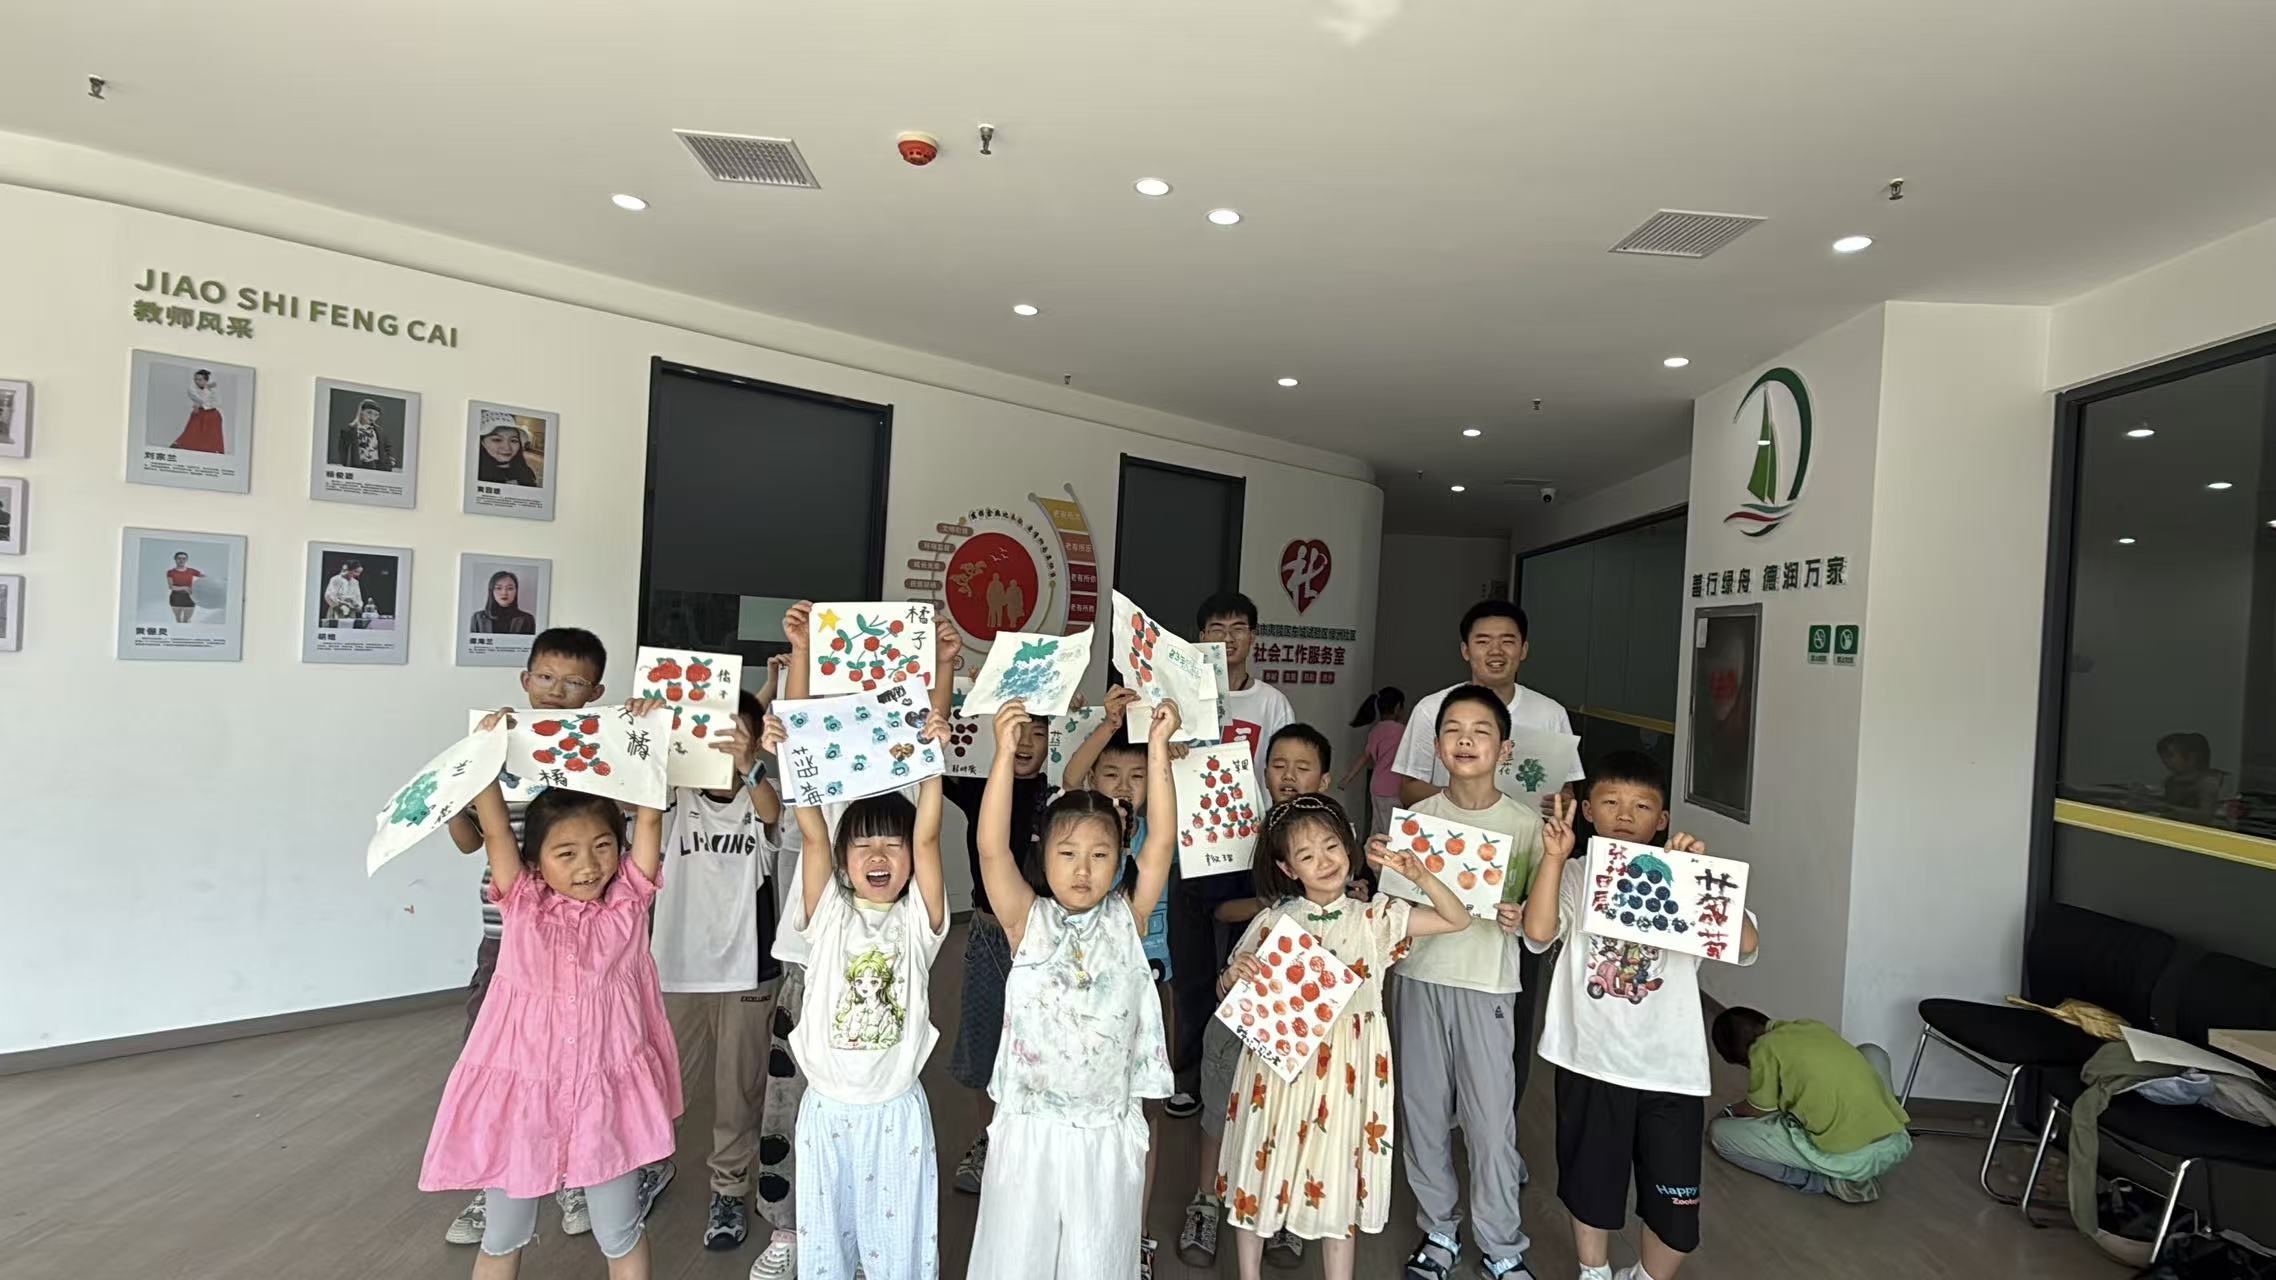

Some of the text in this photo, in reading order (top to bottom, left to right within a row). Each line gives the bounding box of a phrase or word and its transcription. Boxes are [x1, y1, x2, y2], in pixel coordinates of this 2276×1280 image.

[132, 300, 254, 339] 教师风采
[134, 268, 458, 348] JIAO SHI FENG CAI
[1691, 556, 1846, 597] 善行绿舟 德润万家
[905, 605, 931, 650] 橘子
[1253, 642, 1346, 665] 社会工作服务室
[1655, 1184, 1698, 1198] Happy
